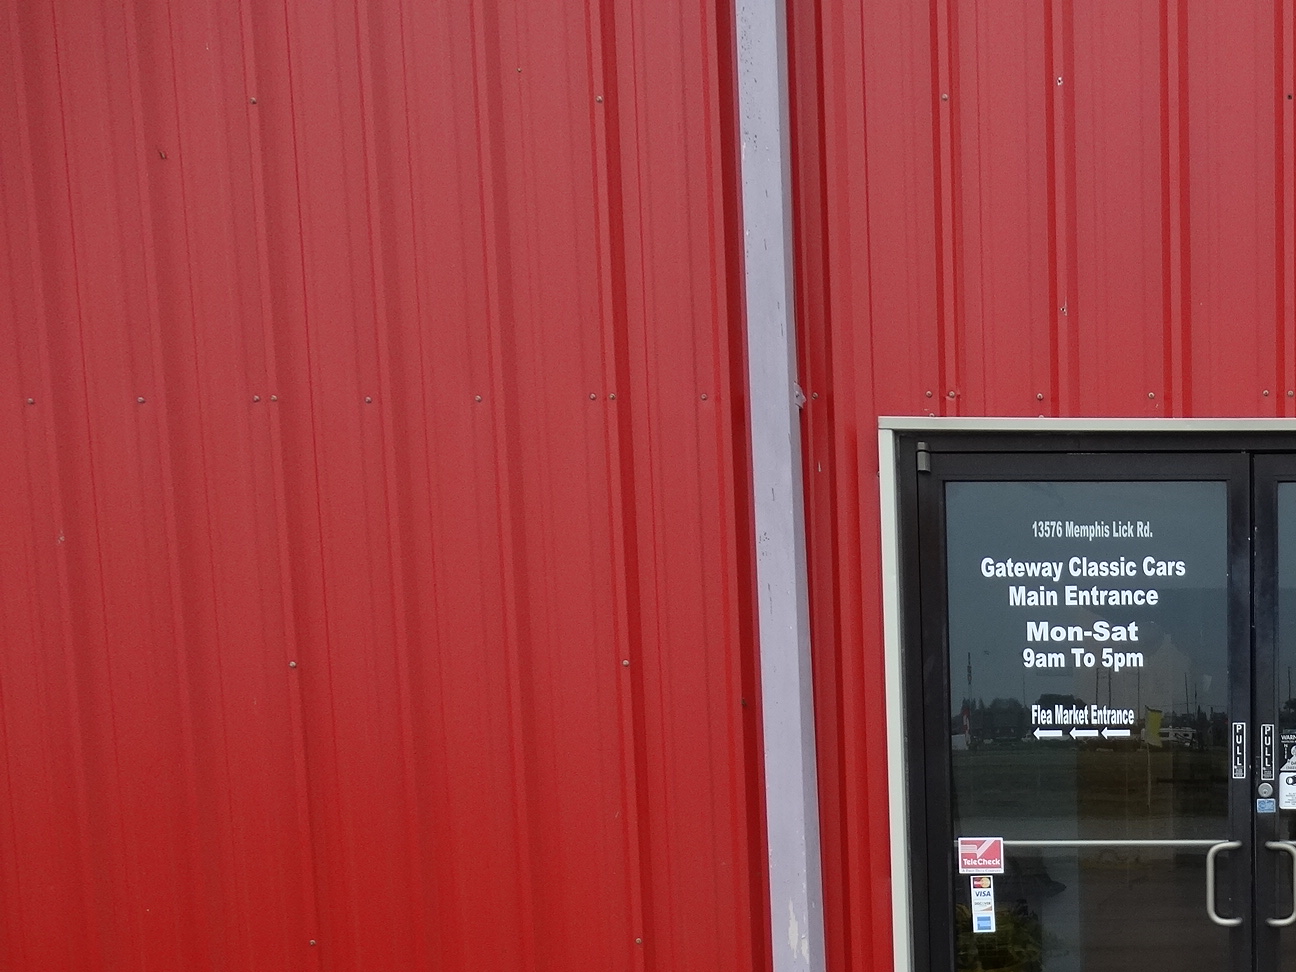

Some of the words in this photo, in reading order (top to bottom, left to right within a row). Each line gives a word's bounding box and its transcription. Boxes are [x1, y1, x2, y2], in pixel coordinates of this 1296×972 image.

[1032, 521, 1062, 538] 13576
[1065, 521, 1110, 541] Memphis
[1112, 521, 1134, 538] Lick
[1136, 521, 1153, 538] Rd.
[981, 557, 1063, 581] Gateway
[1068, 557, 1137, 577] Classic
[1142, 556, 1186, 576] Cars
[1009, 586, 1058, 606] Main
[1064, 585, 1159, 606] Entrance
[1026, 621, 1139, 641] Mon-Sat
[1023, 648, 1065, 668] 9am
[1071, 648, 1096, 668] To
[1101, 648, 1144, 672] 5pm
[1031, 705, 1052, 725] Flea
[1054, 705, 1088, 725] Market
[1090, 704, 1134, 725] Entrance
[1235, 724, 1243, 766] PULL
[962, 858, 1001, 866] TeleCheck
